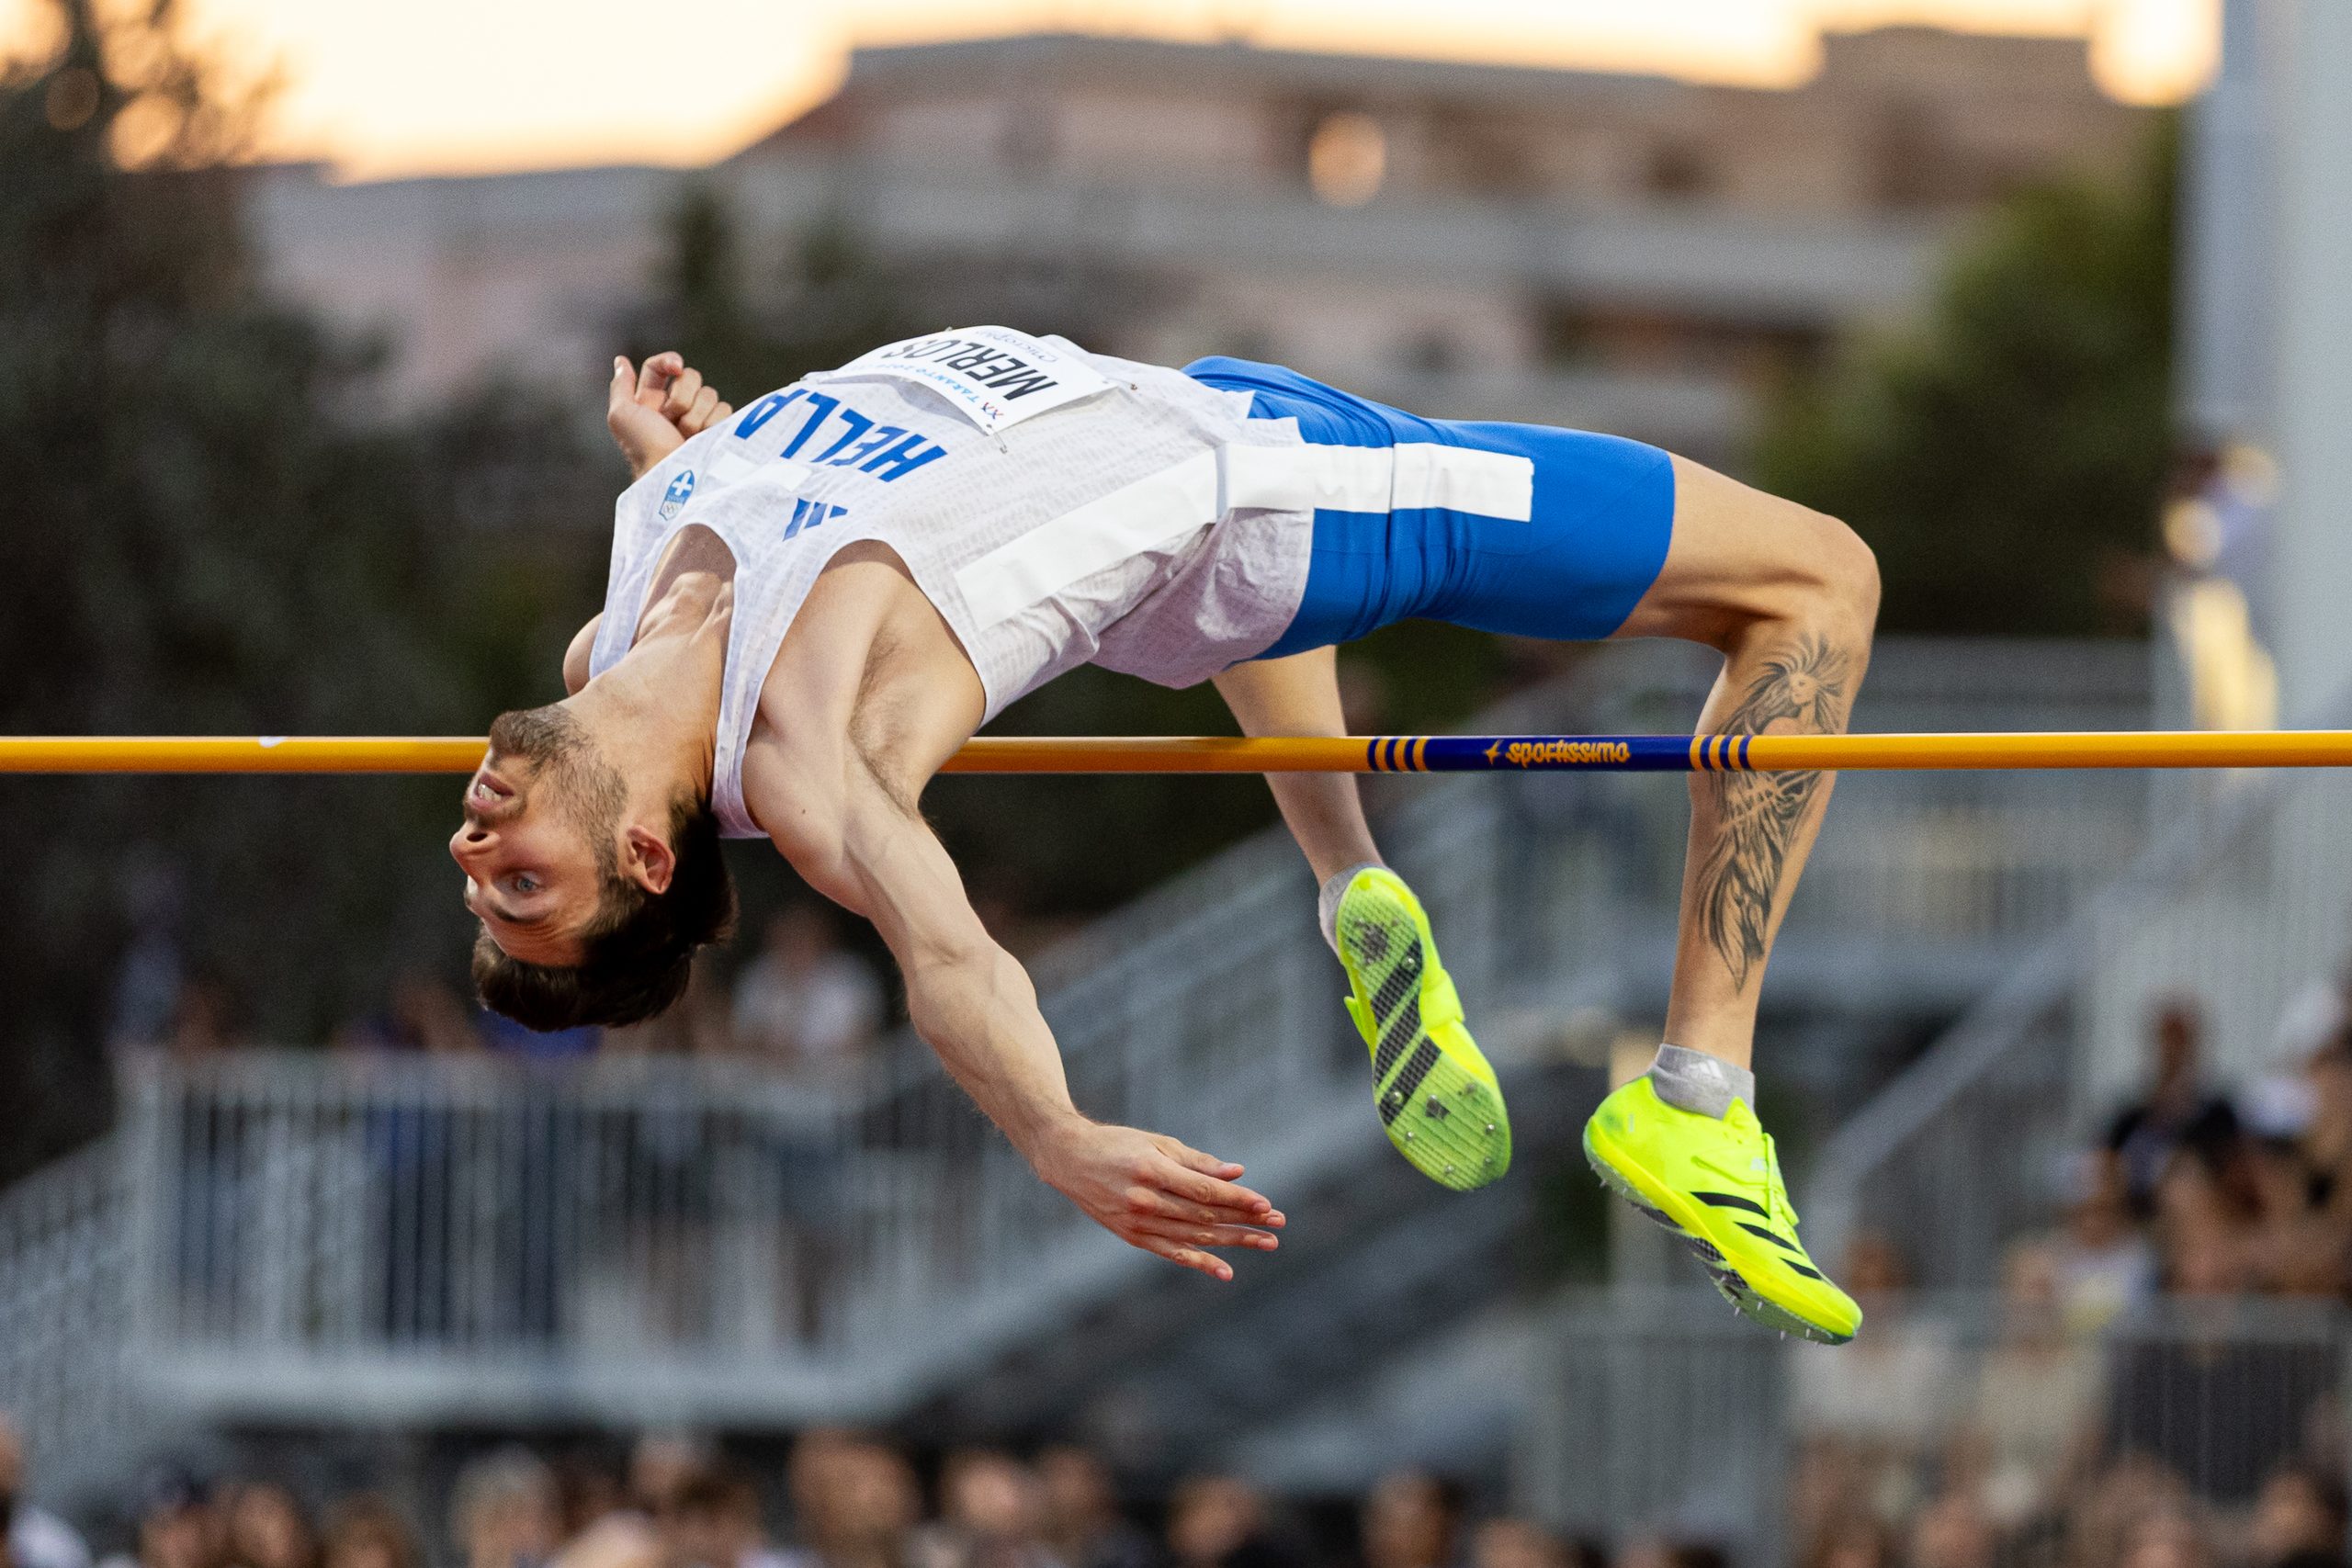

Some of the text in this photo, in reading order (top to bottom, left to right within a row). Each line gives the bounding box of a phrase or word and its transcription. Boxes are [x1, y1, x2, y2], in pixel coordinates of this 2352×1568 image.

[881, 339, 1059, 400] MERLOS
[915, 367, 979, 403] TARANTO
[1505, 739, 1631, 769] sportissimo
